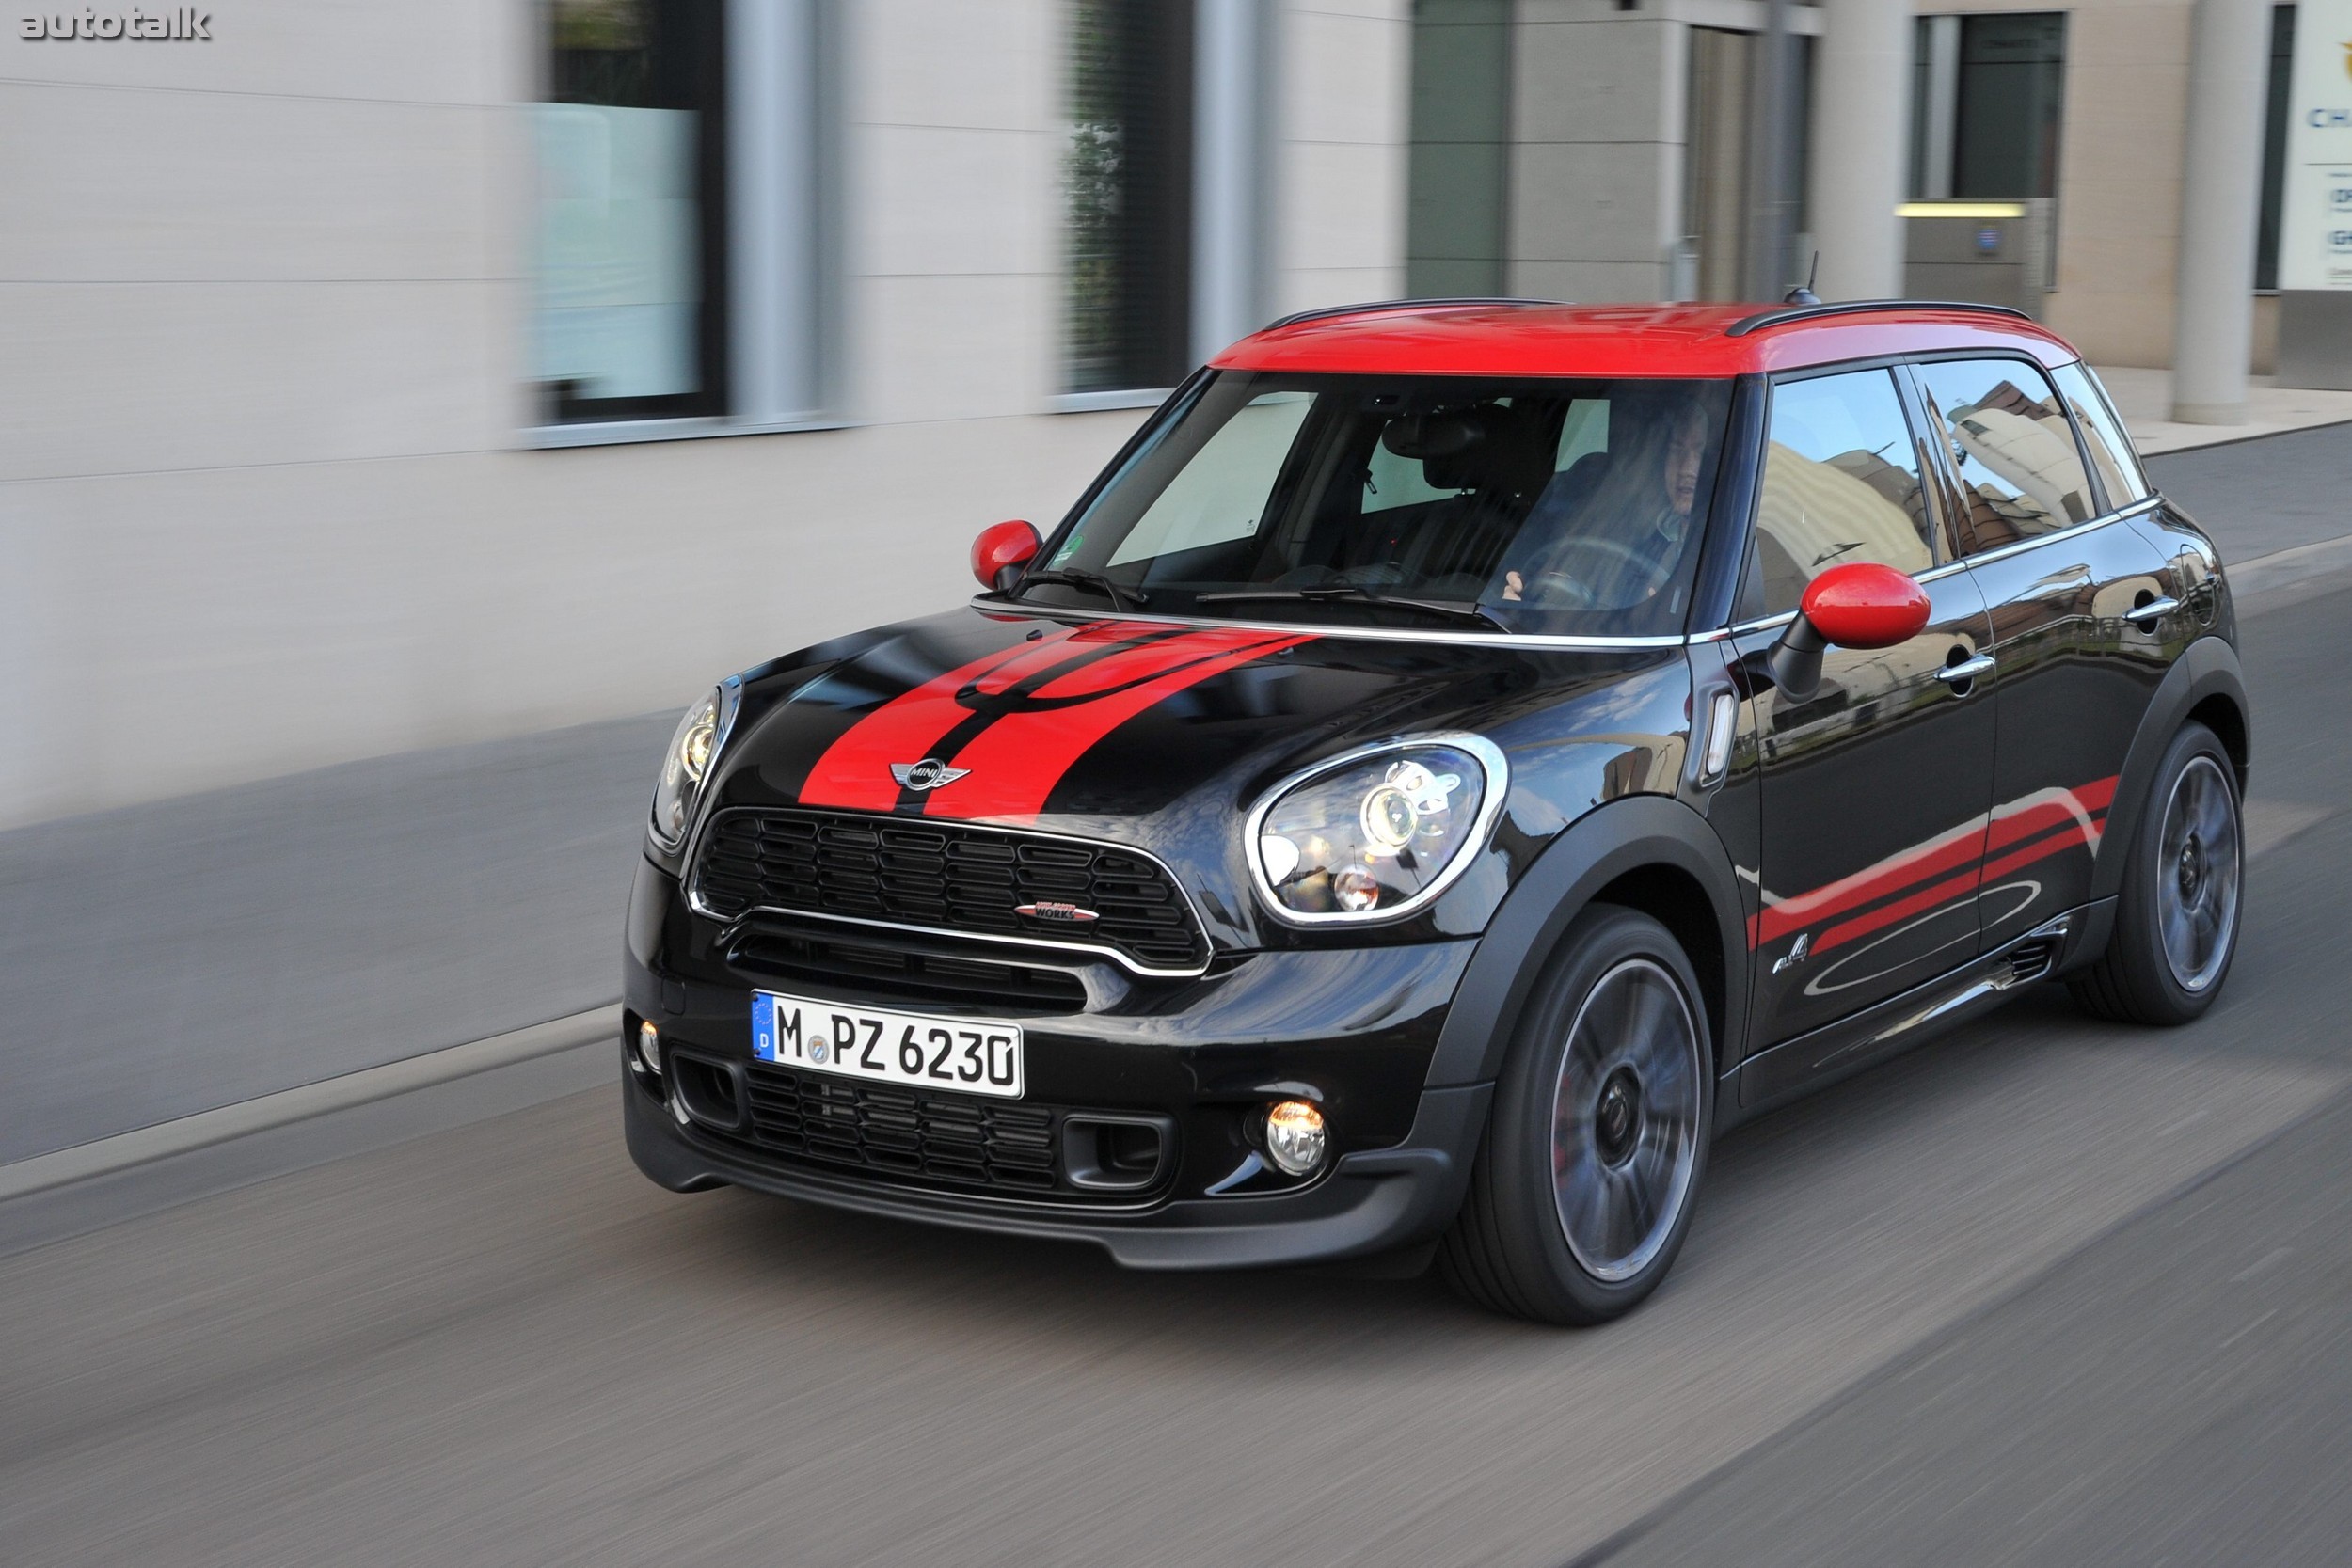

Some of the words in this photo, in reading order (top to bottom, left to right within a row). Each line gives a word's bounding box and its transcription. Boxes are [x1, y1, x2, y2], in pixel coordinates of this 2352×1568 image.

[910, 767, 938, 778] MINI
[1035, 908, 1075, 919] WORKS
[759, 1033, 770, 1048] D
[777, 1006, 802, 1058] M
[832, 1014, 885, 1070] PZ
[899, 1025, 1014, 1085] 6230
